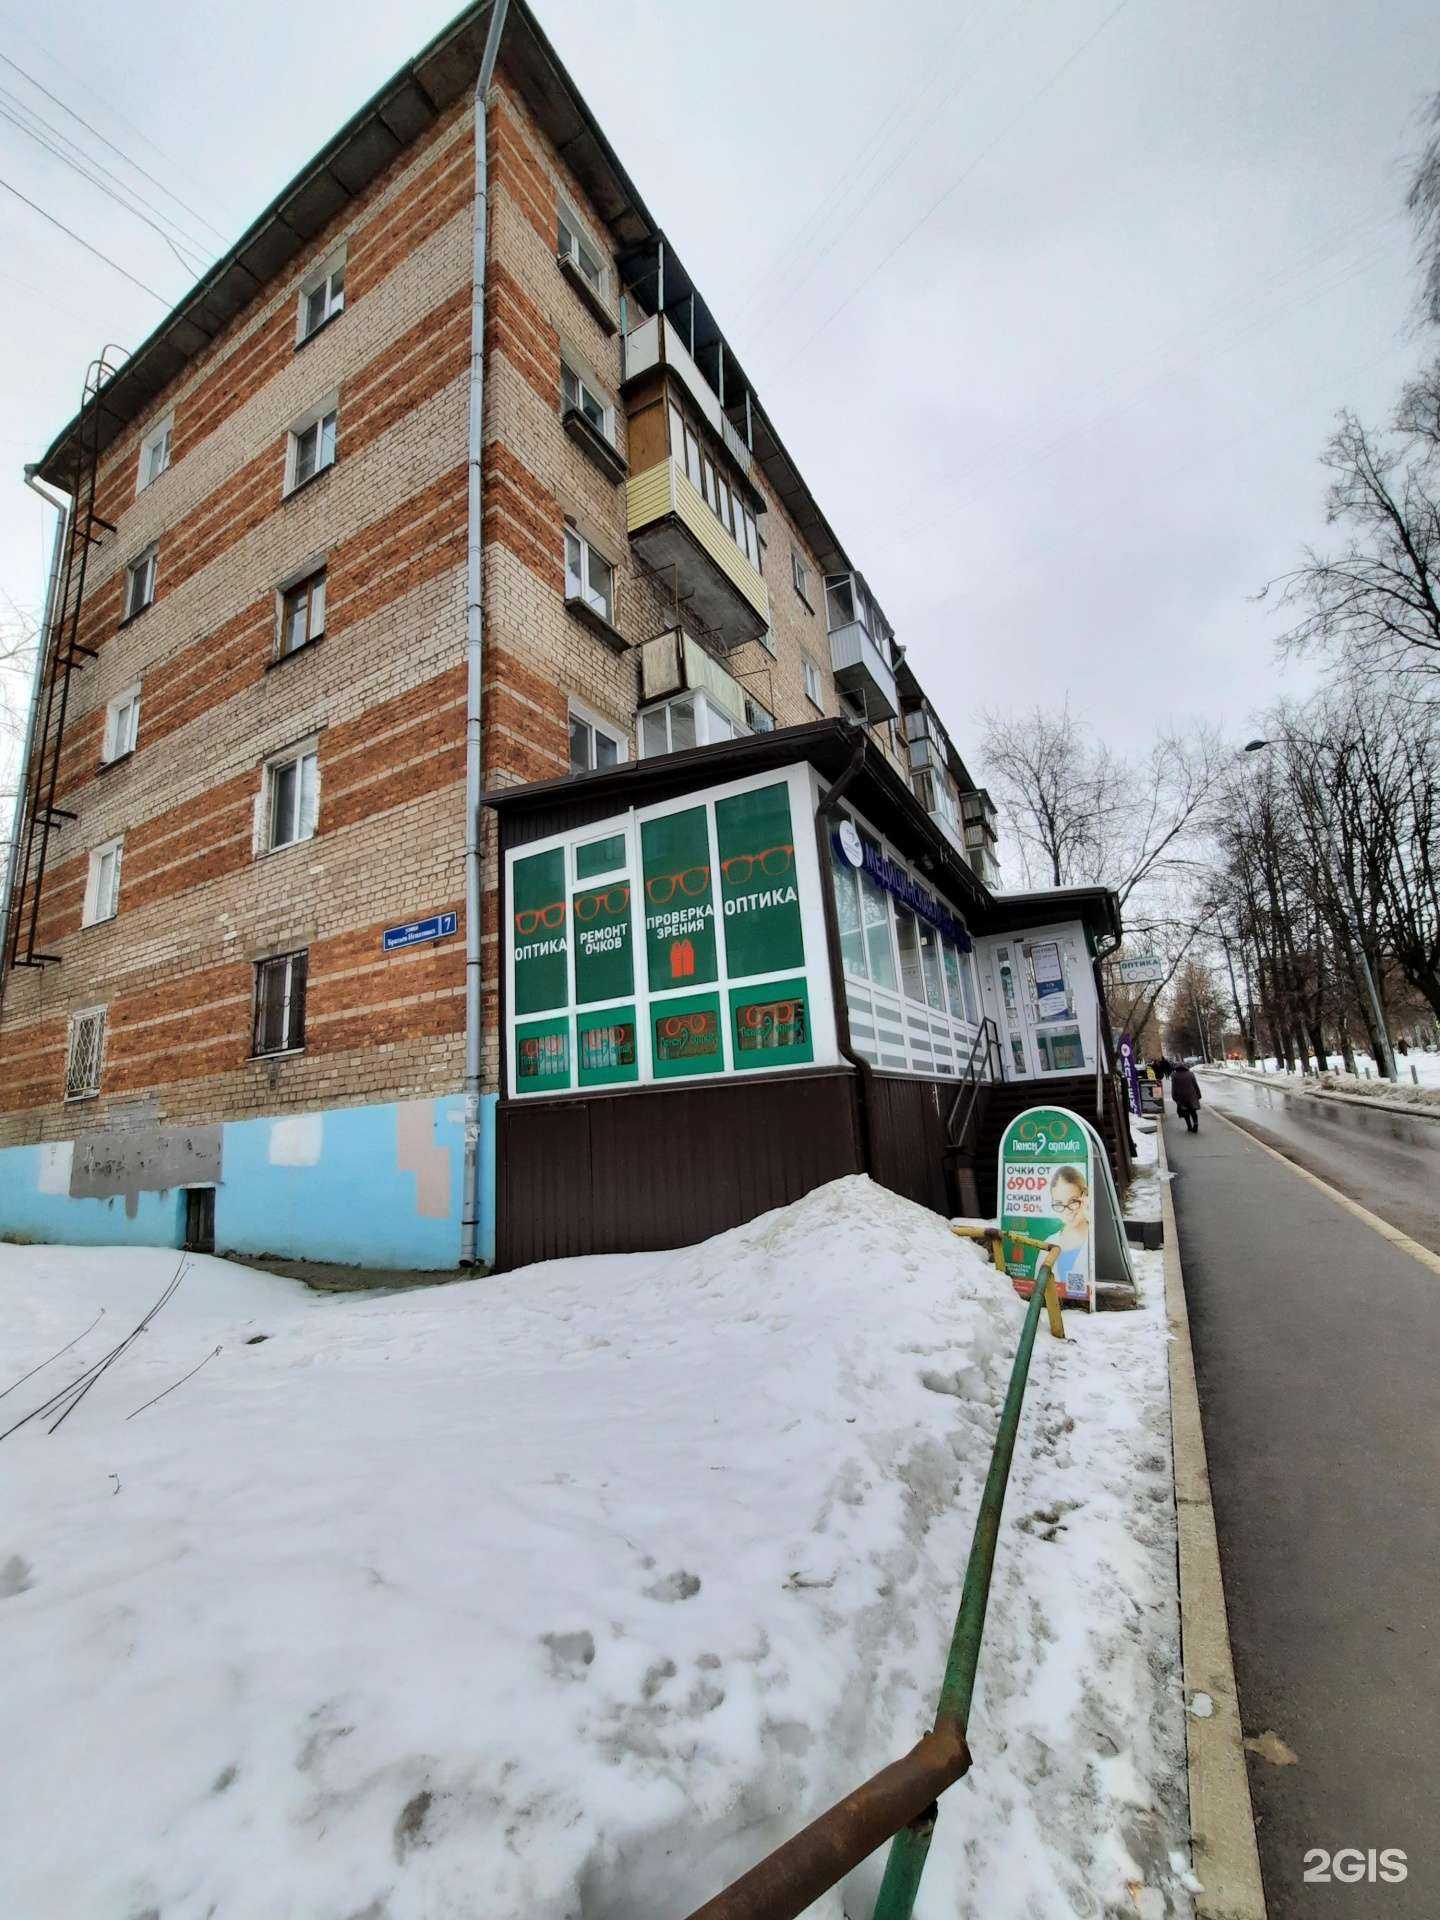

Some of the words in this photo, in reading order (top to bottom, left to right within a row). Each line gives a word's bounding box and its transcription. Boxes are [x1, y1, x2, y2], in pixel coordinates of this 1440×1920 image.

[724, 886, 798, 916] ОПТИКА
[444, 916, 452, 931] 7
[646, 904, 714, 930] ПРОВЕРКА
[580, 922, 628, 945] РЕМОНТ
[656, 919, 704, 940] ЗРЕНИЯ
[514, 937, 568, 961] ОПТИКА
[585, 936, 622, 955] ОЧКОВ
[1121, 960, 1159, 970] ОПТИКА
[1006, 1166, 1035, 1175] ОЧКИ
[1037, 1166, 1051, 1175] ОТ
[1006, 1193, 1042, 1202] СКИДКИ
[1006, 1202, 1021, 1212] ДО
